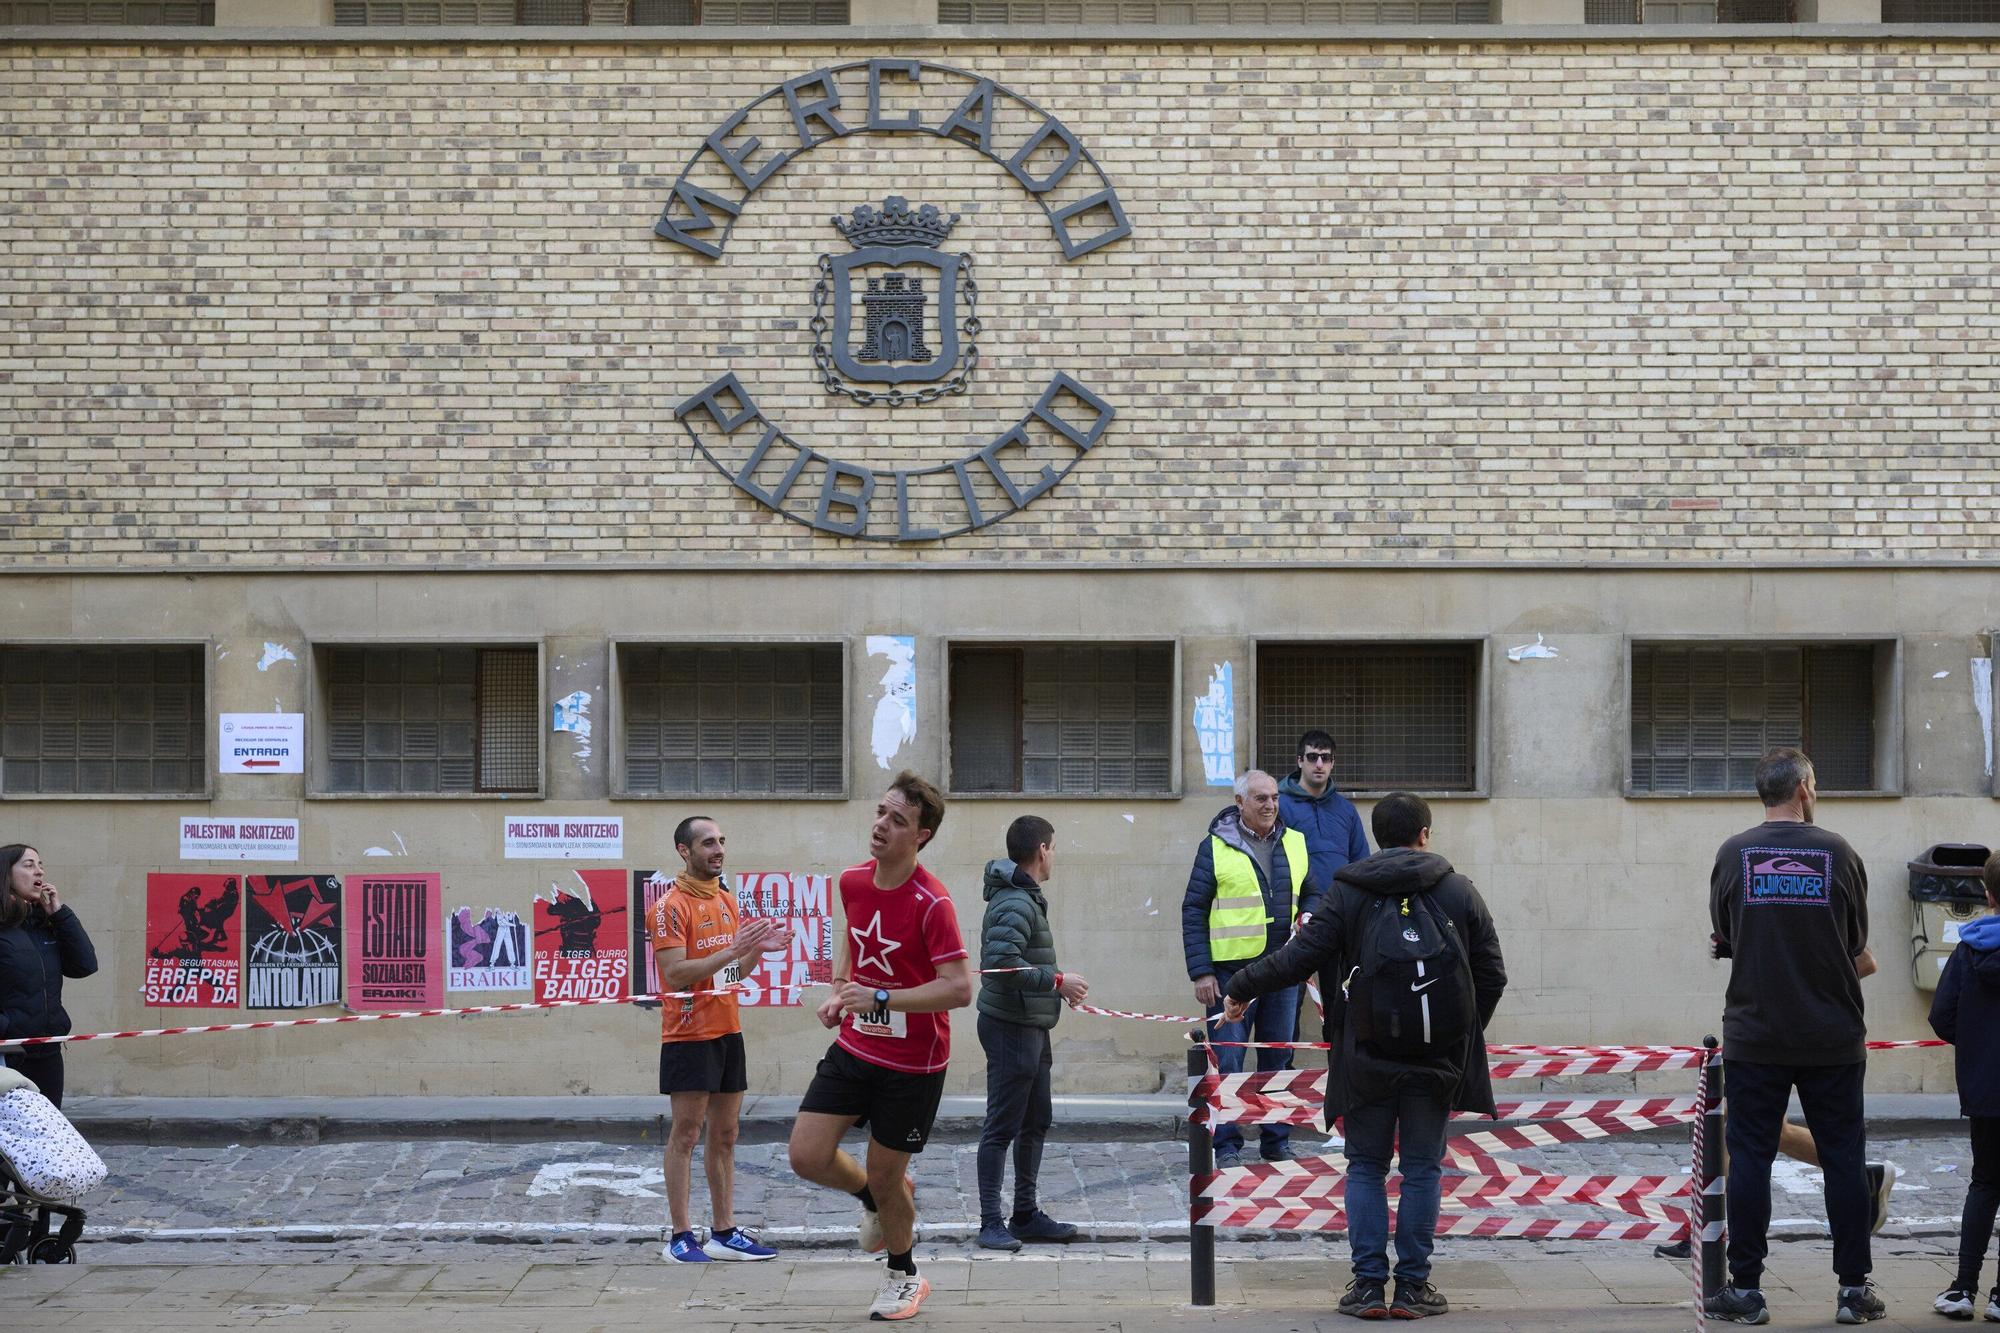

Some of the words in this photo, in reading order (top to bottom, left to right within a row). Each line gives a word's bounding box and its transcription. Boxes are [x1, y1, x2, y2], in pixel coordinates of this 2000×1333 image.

[655, 59, 1132, 260] MERCADO
[675, 371, 1117, 541] PUBLICO
[234, 748, 289, 756] ENTRADA
[184, 824, 236, 839] PALESTINA
[240, 825, 295, 840] ASKATZEKO
[508, 823, 560, 838] PALESTINA
[564, 824, 619, 838] ASKATZEKO
[736, 873, 828, 917] KOM
[738, 891, 772, 900] GAZTE
[738, 900, 797, 908] LANGILEOK
[363, 884, 427, 958] ESTATU
[739, 908, 822, 918] ANTOLAKUNTZA
[535, 950, 548, 960] NO
[553, 950, 591, 959] ELIGES
[596, 949, 628, 958] CURRO
[147, 959, 158, 967] EZ
[163, 959, 174, 967] DA
[179, 959, 239, 968] SEGURTASUNA
[535, 959, 628, 979] ELIGES
[147, 968, 239, 986] ERREPRE
[363, 963, 426, 984] SOZIALISTA
[450, 971, 518, 988] ERAIKI
[724, 967, 741, 983] 280
[146, 986, 198, 1004] SIOA
[212, 986, 237, 1004] DA
[362, 989, 417, 998] ERAIKI
[543, 978, 620, 999] BANDO
